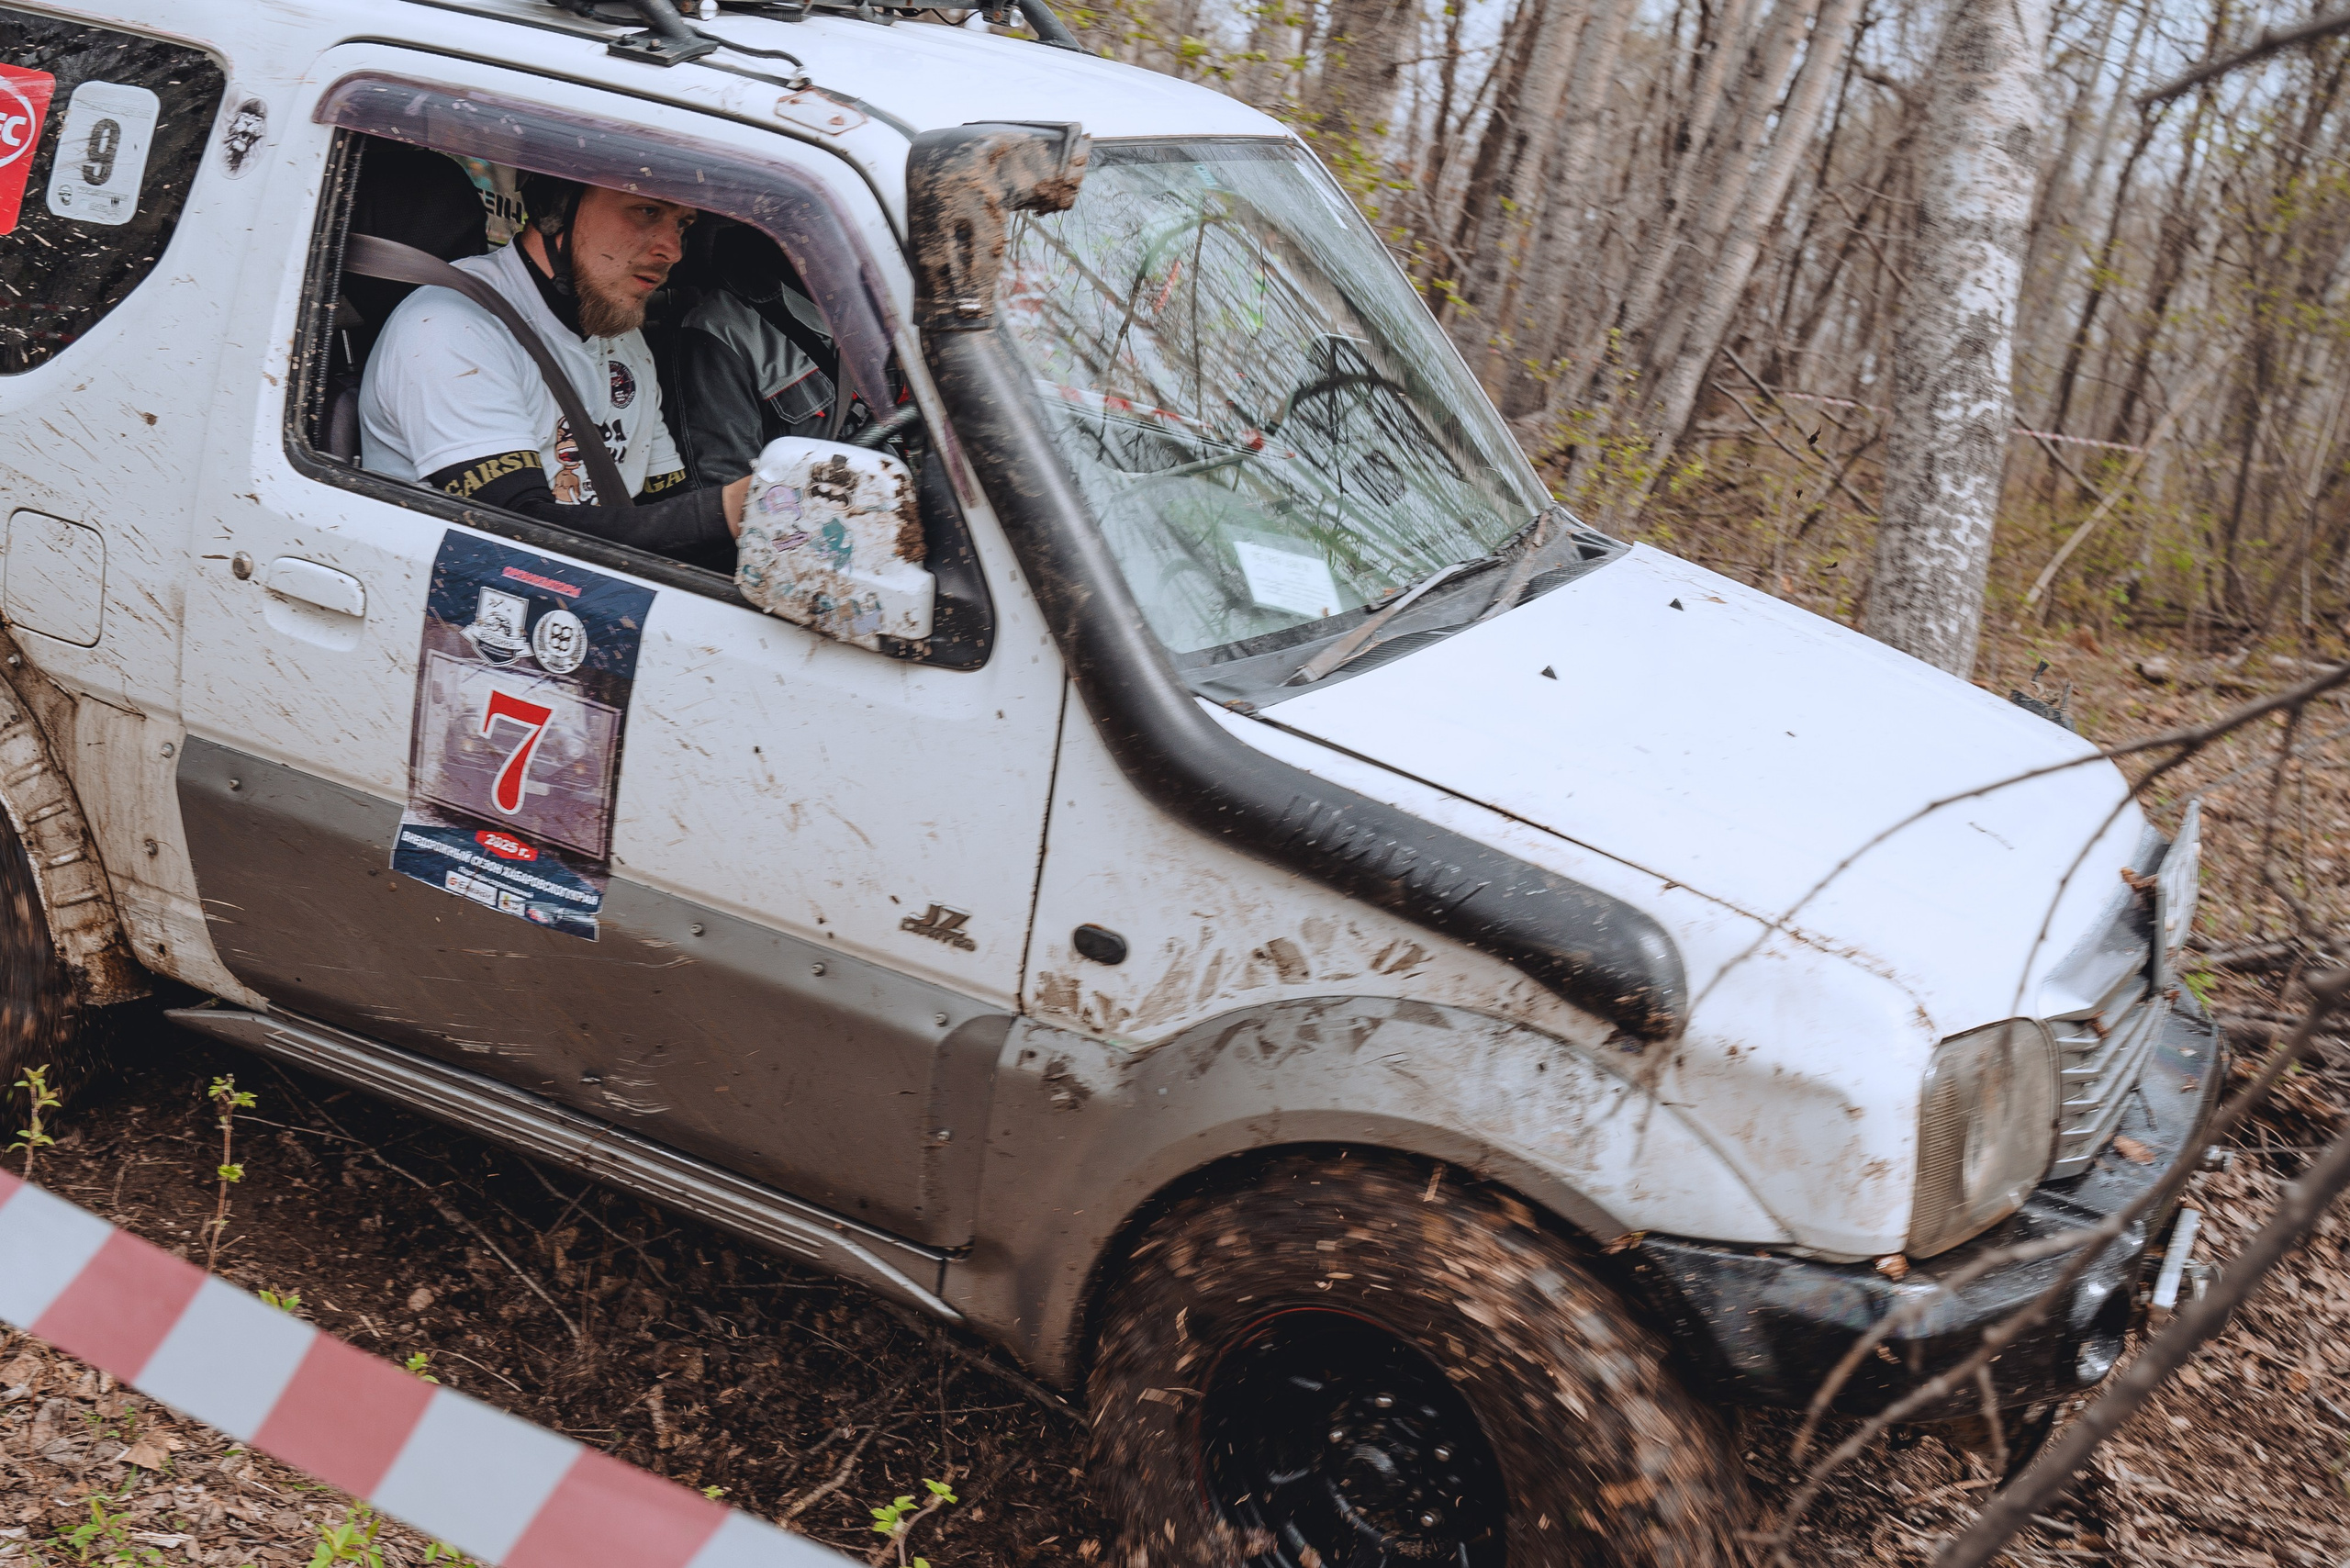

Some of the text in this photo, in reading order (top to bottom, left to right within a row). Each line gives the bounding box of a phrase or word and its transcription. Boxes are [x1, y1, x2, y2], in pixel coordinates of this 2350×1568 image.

[83, 118, 121, 186] 9
[480, 689, 554, 813] 7
[400, 831, 473, 863] ВНЕДОРОЖНЫЙ
[470, 856, 503, 874] СЕЗОН
[484, 834, 520, 855] 2025
